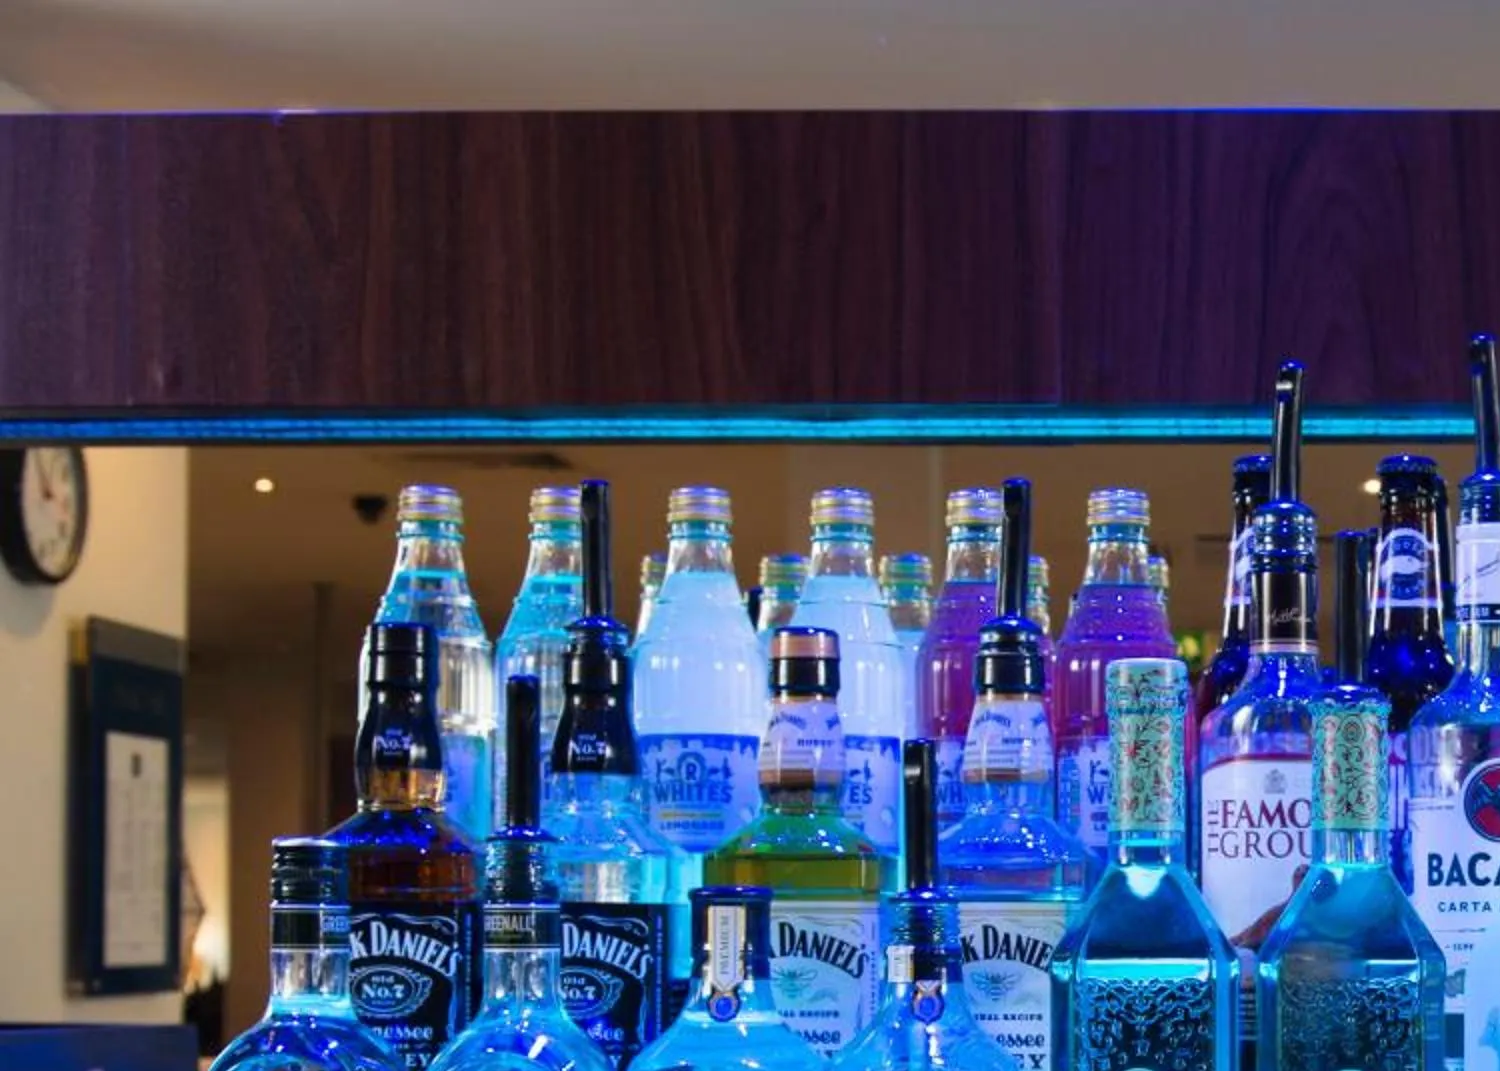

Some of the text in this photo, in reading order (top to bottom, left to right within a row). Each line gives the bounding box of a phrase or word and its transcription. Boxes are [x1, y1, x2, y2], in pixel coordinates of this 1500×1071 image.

[653, 781, 733, 805] WHITES
[1437, 901, 1493, 913] CARTA
[369, 920, 463, 977] DANIEL'S
[561, 921, 655, 980] DANIEL'S
[777, 920, 871, 979] DANIEL'S
